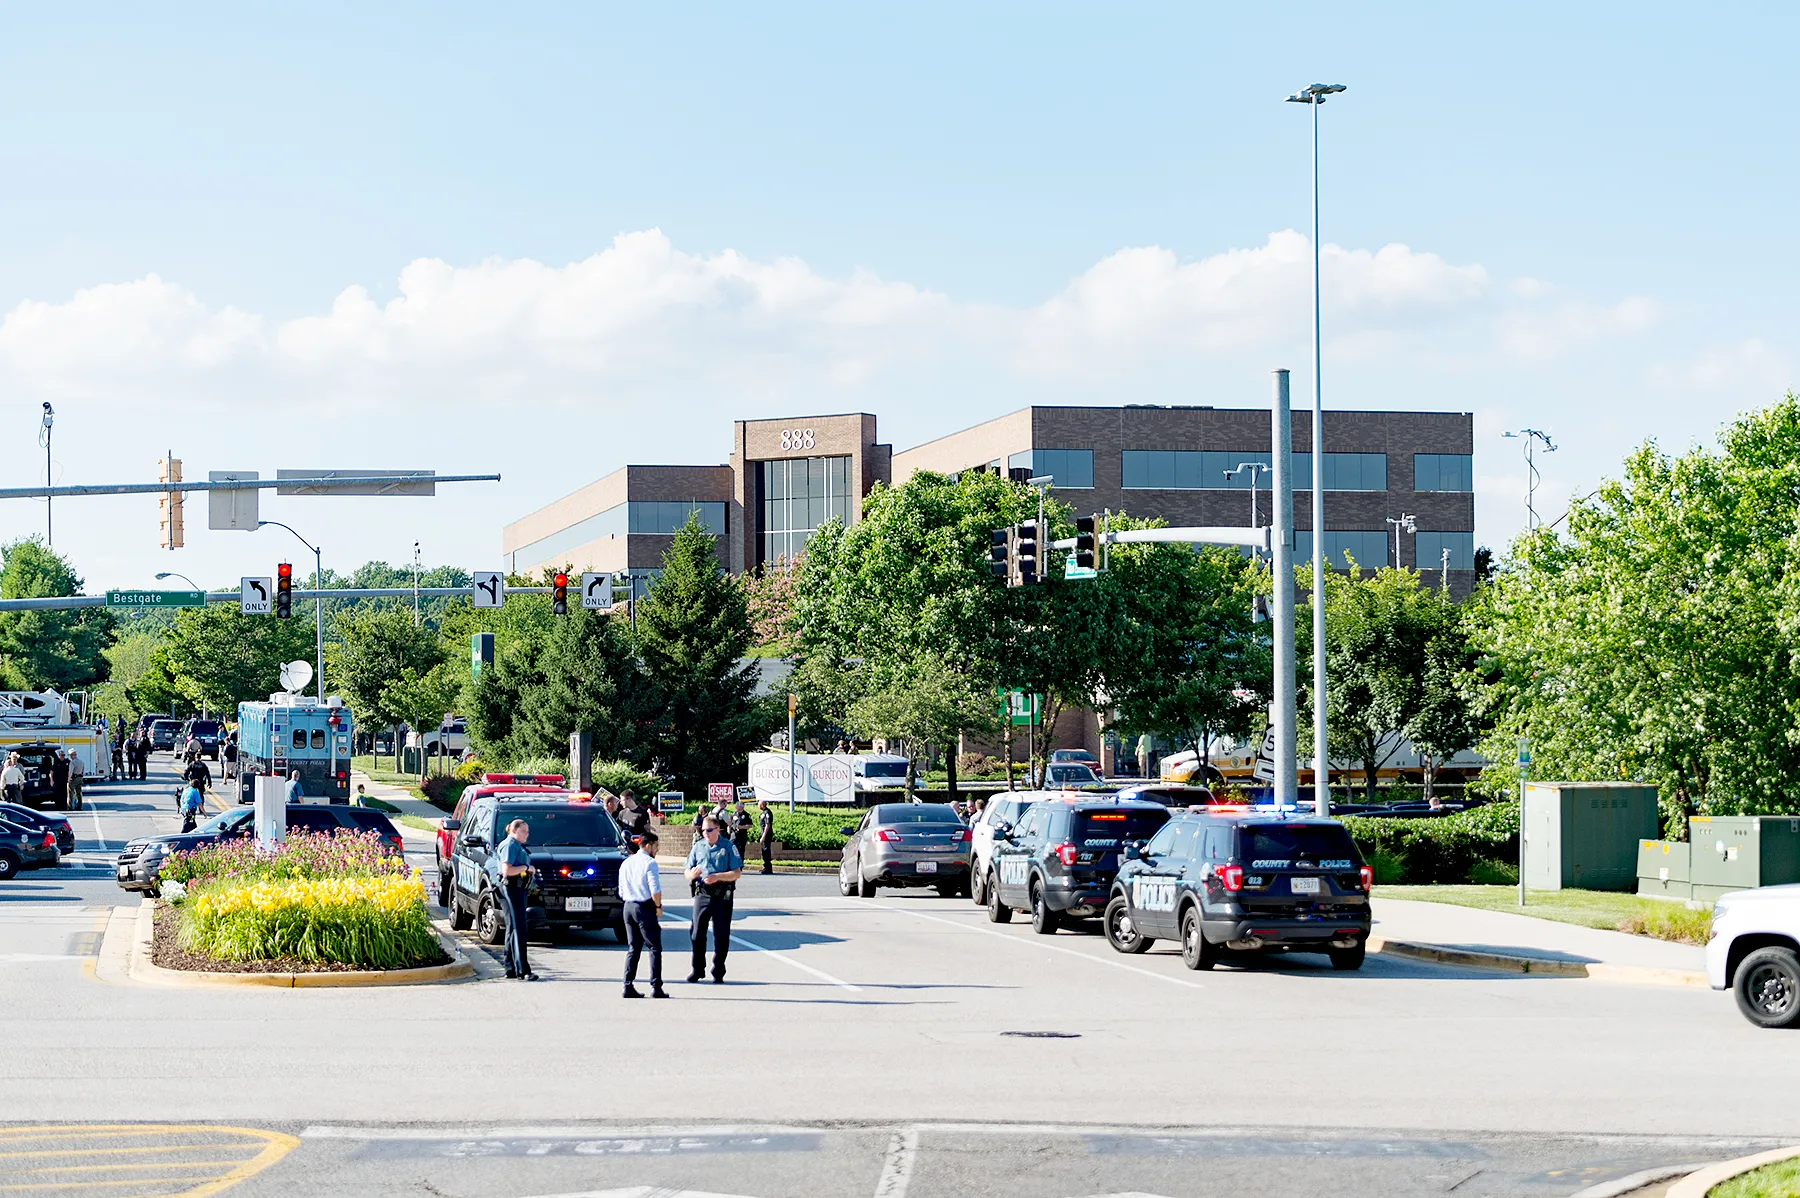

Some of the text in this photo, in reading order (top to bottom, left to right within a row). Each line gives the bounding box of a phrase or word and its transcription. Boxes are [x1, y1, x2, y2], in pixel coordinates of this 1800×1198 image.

[781, 429, 815, 450] 888
[113, 593, 162, 606] Bestgate
[585, 597, 607, 606] ONLY
[245, 603, 268, 611] ONLY
[755, 768, 799, 779] BURTON
[812, 769, 848, 780] BURTON
[710, 785, 732, 796] O'SHEA
[1252, 860, 1290, 868] COUNTY
[1005, 861, 1029, 884] POLICE
[1139, 884, 1176, 912] POLICE
